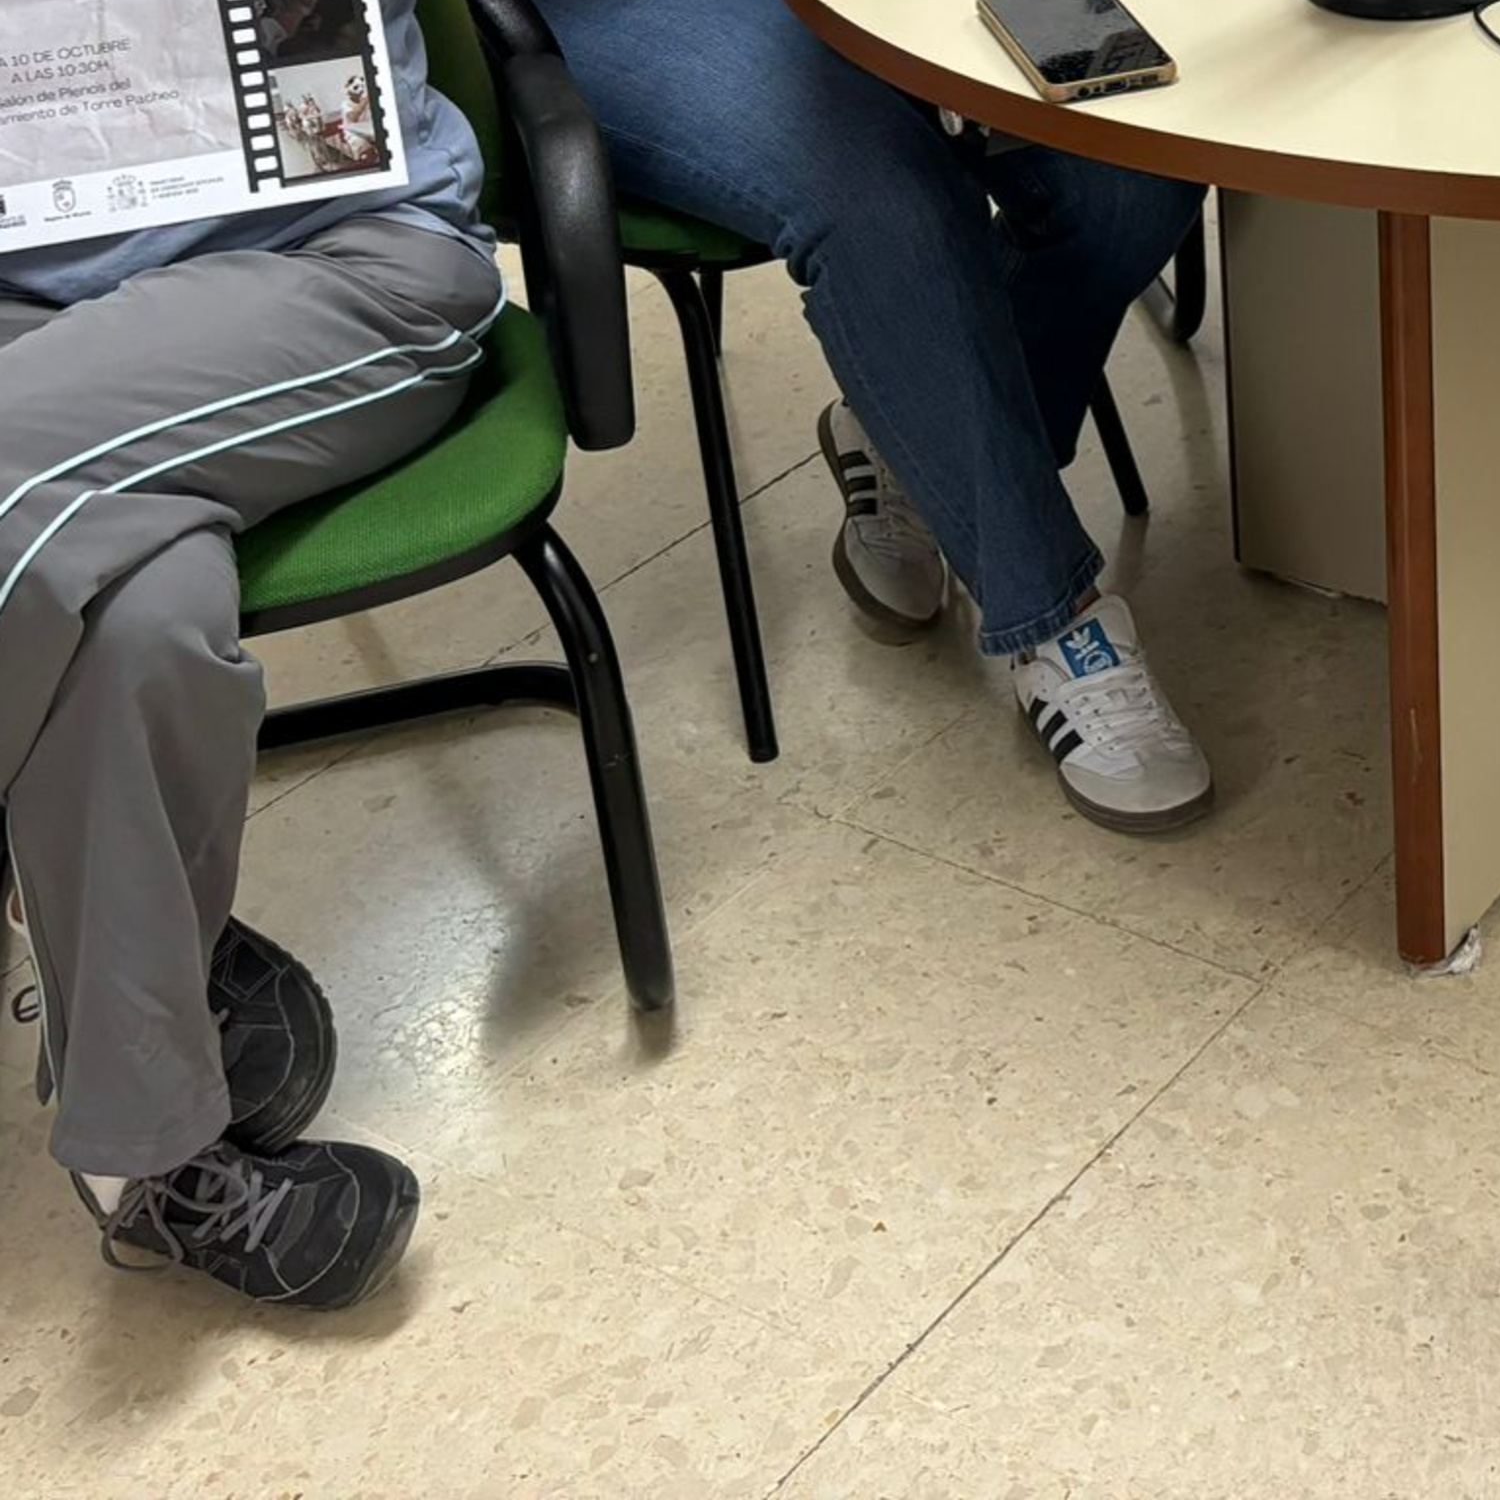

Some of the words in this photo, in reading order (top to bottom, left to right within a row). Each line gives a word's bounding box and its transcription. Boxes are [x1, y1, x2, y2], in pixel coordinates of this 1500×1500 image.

[11, 54, 29, 67] 10
[33, 50, 54, 63] DE
[57, 39, 131, 60] OCTUBRE
[11, 72, 23, 83] A
[25, 67, 54, 82] LAS
[37, 90, 55, 102] de
[58, 83, 106, 100] Plenos
[109, 77, 131, 92] del
[59, 104, 78, 116] de
[82, 99, 123, 112] Torre
